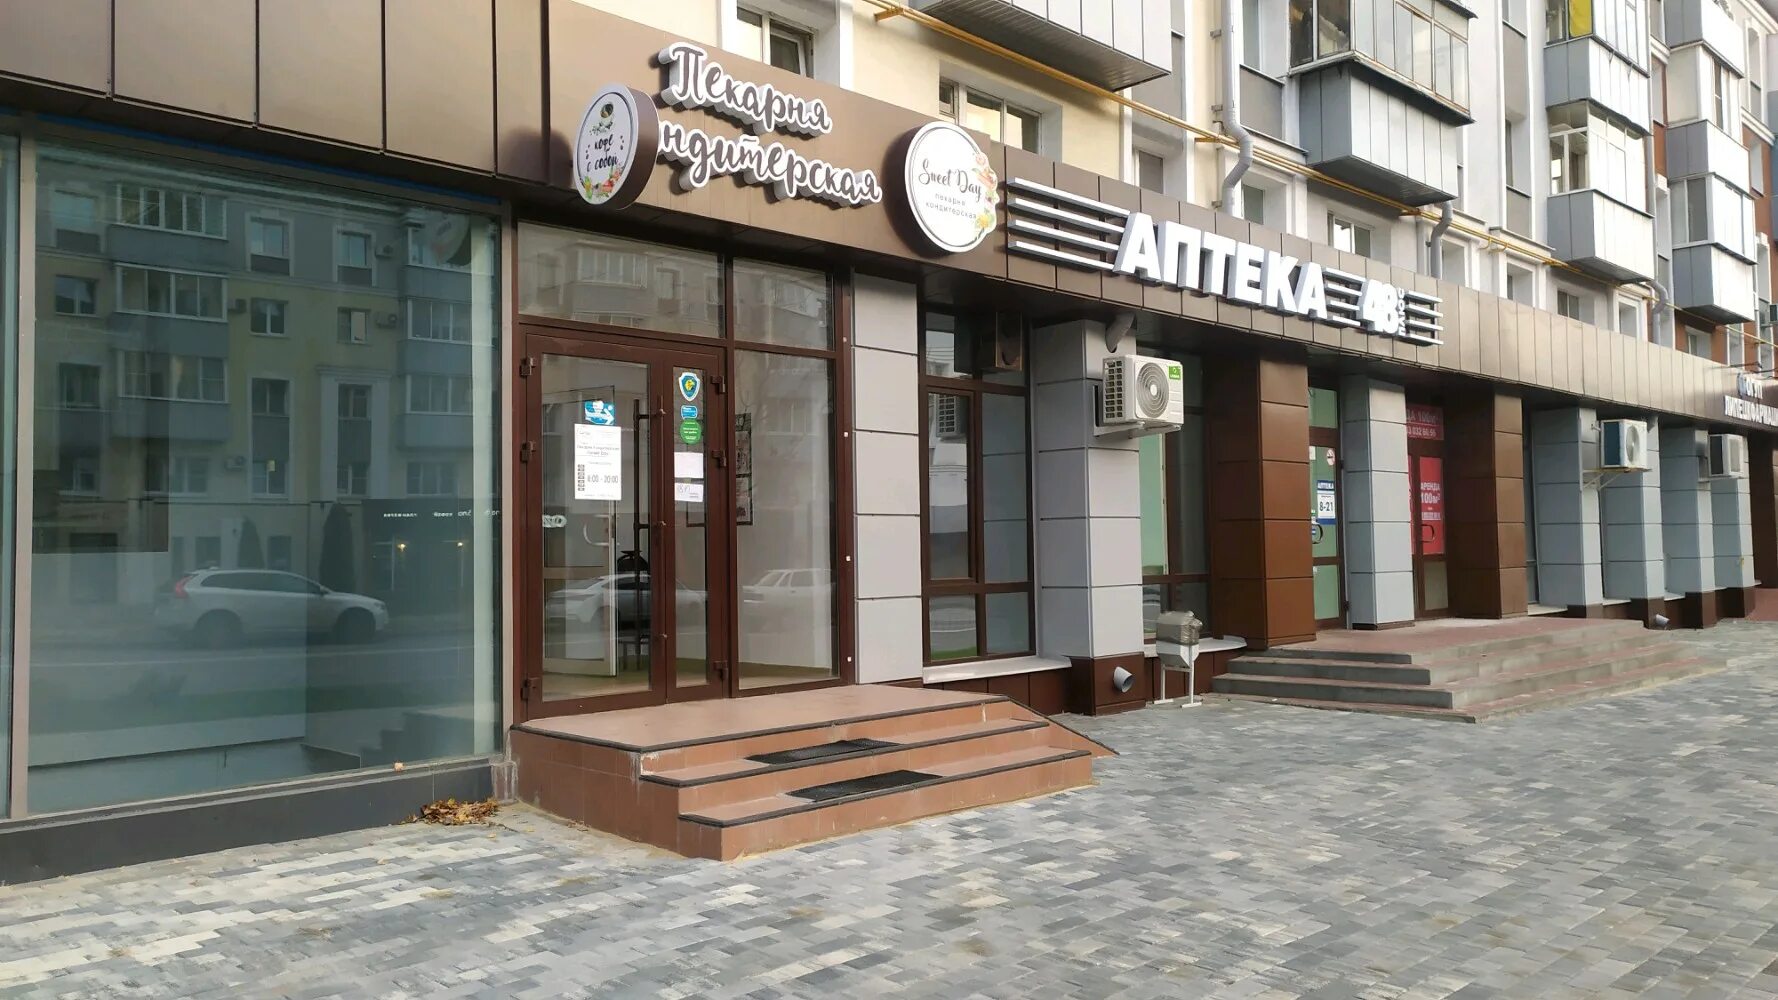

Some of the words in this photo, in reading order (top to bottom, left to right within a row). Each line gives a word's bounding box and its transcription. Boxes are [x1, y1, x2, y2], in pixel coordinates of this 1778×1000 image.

[670, 42, 832, 133] Пекарня
[594, 134, 614, 156] кофе
[659, 120, 882, 203] ндитерская
[918, 158, 953, 187] Sweet
[956, 169, 981, 203] Day
[926, 202, 977, 219] кондитерская
[1113, 212, 1328, 320] АПТЕКА
[1358, 280, 1399, 336] 48
[1319, 501, 1333, 512] 8-21
